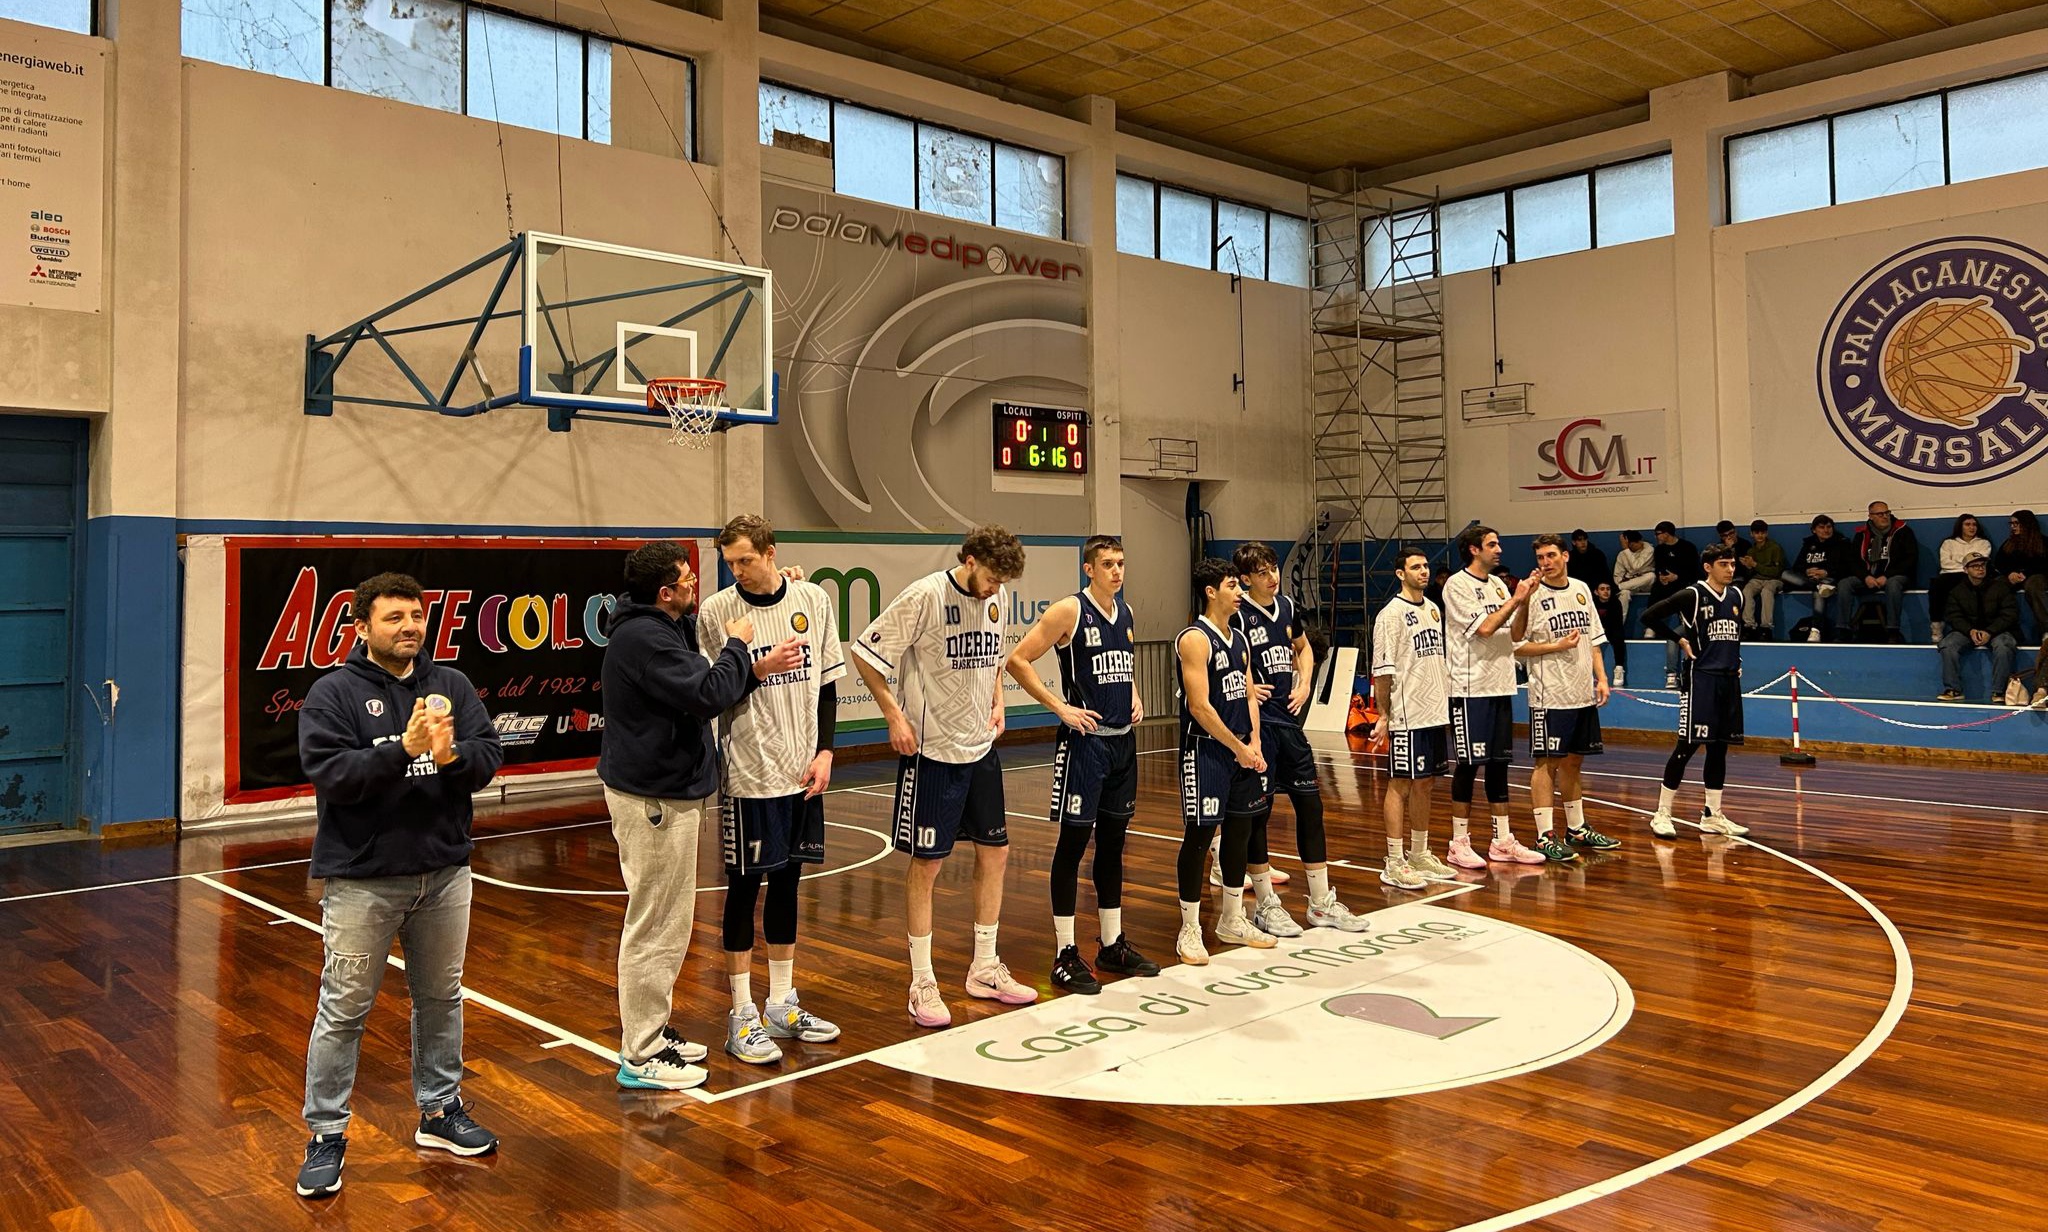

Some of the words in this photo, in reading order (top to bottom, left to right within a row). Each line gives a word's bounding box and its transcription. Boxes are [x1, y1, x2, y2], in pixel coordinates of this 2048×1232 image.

[11, 88, 47, 101] integrata
[13, 116, 21, 124] di
[22, 118, 47, 128] calore
[14, 107, 22, 115] di
[24, 109, 84, 126] climatizzazione
[18, 126, 48, 137] radianti
[14, 152, 41, 163] termici
[18, 143, 61, 157] fotovoltaici
[8, 178, 30, 188] home
[30, 210, 62, 222] aleo
[30, 233, 70, 244] Buderus
[43, 226, 70, 236] BOSCH
[34, 246, 66, 256] wavin
[48, 268, 82, 278] MITSUBISHI
[48, 273, 76, 282] ELECTRIC
[1004, 406, 1032, 416] LOCALI
[1056, 410, 1082, 420] OSPITI
[1016, 420, 1027, 442] 0
[1043, 427, 1047, 442] 1
[1067, 424, 1078, 446] 0
[1002, 447, 1011, 466] 0
[1029, 445, 1067, 468] 6:16
[1074, 452, 1082, 469] 0
[1544, 488, 1586, 496] INFORMATION
[1587, 486, 1629, 495] TECHNOLOGY
[1540, 597, 1556, 612] 67
[944, 605, 961, 624] 10
[1700, 605, 1714, 620] 73
[477, 592, 617, 654] COLO
[1548, 610, 1590, 632] DIERRE
[1084, 626, 1103, 648] 12
[1248, 626, 1270, 646] 22
[946, 630, 1000, 658] DIERRE
[952, 657, 996, 670] BASKETBALL
[1214, 650, 1230, 672] 20
[497, 675, 534, 698] dal
[537, 677, 587, 696] 1982
[836, 693, 873, 706] 9231966
[492, 711, 548, 734] fiac
[1534, 708, 1545, 750] DIERR
[1694, 724, 1709, 738] 73
[1548, 736, 1562, 751] 67
[1184, 750, 1198, 817] DIERRE
[1066, 793, 1083, 815] 12
[1202, 796, 1220, 816] 20
[916, 826, 937, 849] 10
[749, 840, 762, 864] 7
[976, 1016, 1148, 1062] Casa
[1139, 992, 1210, 1016] di
[1204, 965, 1318, 996] cura
